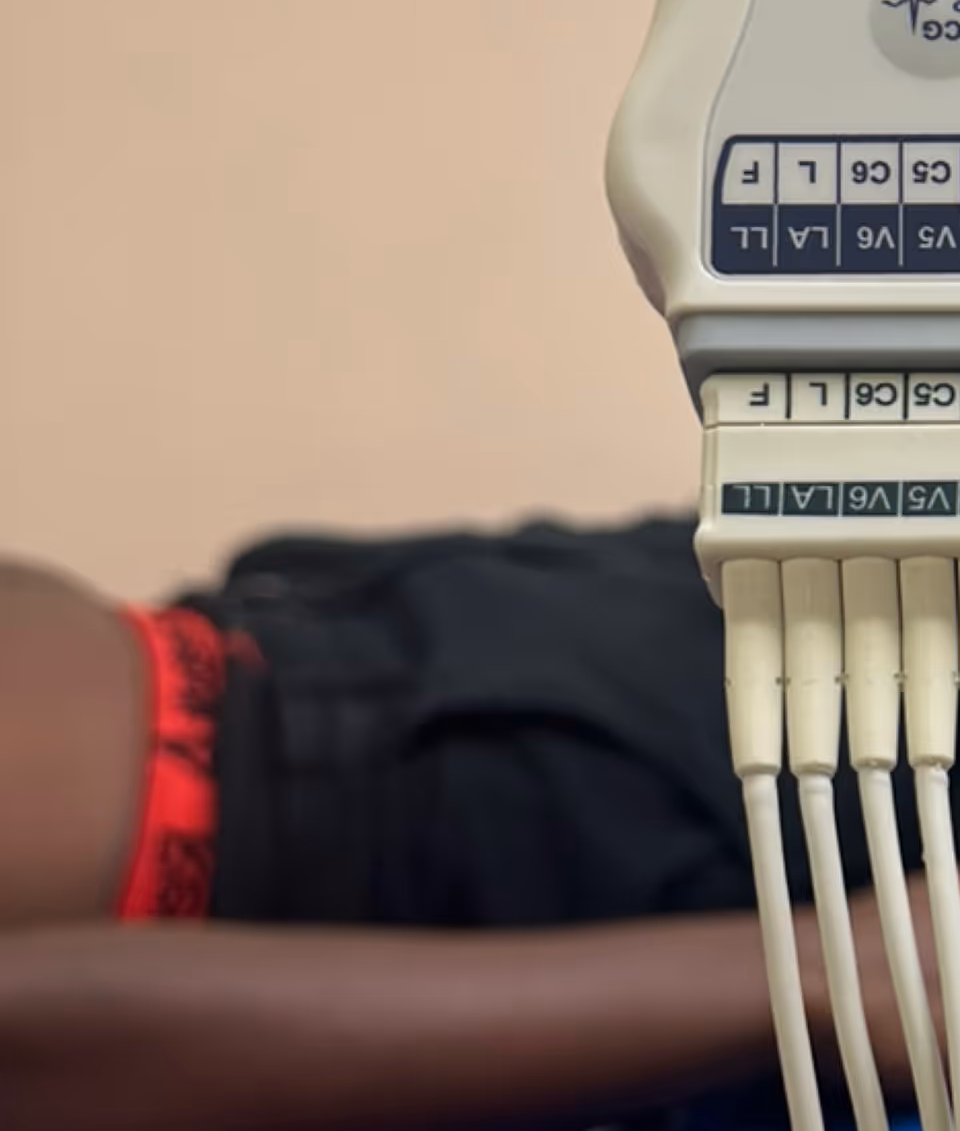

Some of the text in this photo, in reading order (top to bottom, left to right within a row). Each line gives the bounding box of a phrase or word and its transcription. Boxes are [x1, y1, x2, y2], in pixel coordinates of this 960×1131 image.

[741, 160, 759, 184] F
[798, 161, 817, 184] L
[851, 160, 890, 184] C6
[912, 160, 952, 184] C5
[730, 226, 768, 249] LL
[788, 226, 829, 248] LA
[857, 226, 895, 249] V6
[918, 226, 957, 248] V5
[748, 383, 770, 407] F
[809, 383, 827, 406] L
[855, 383, 897, 406] C6
[913, 383, 955, 406] C5
[733, 486, 770, 508] LL
[790, 486, 833, 509] LA
[850, 485, 891, 509] V6
[908, 485, 950, 509] V5
